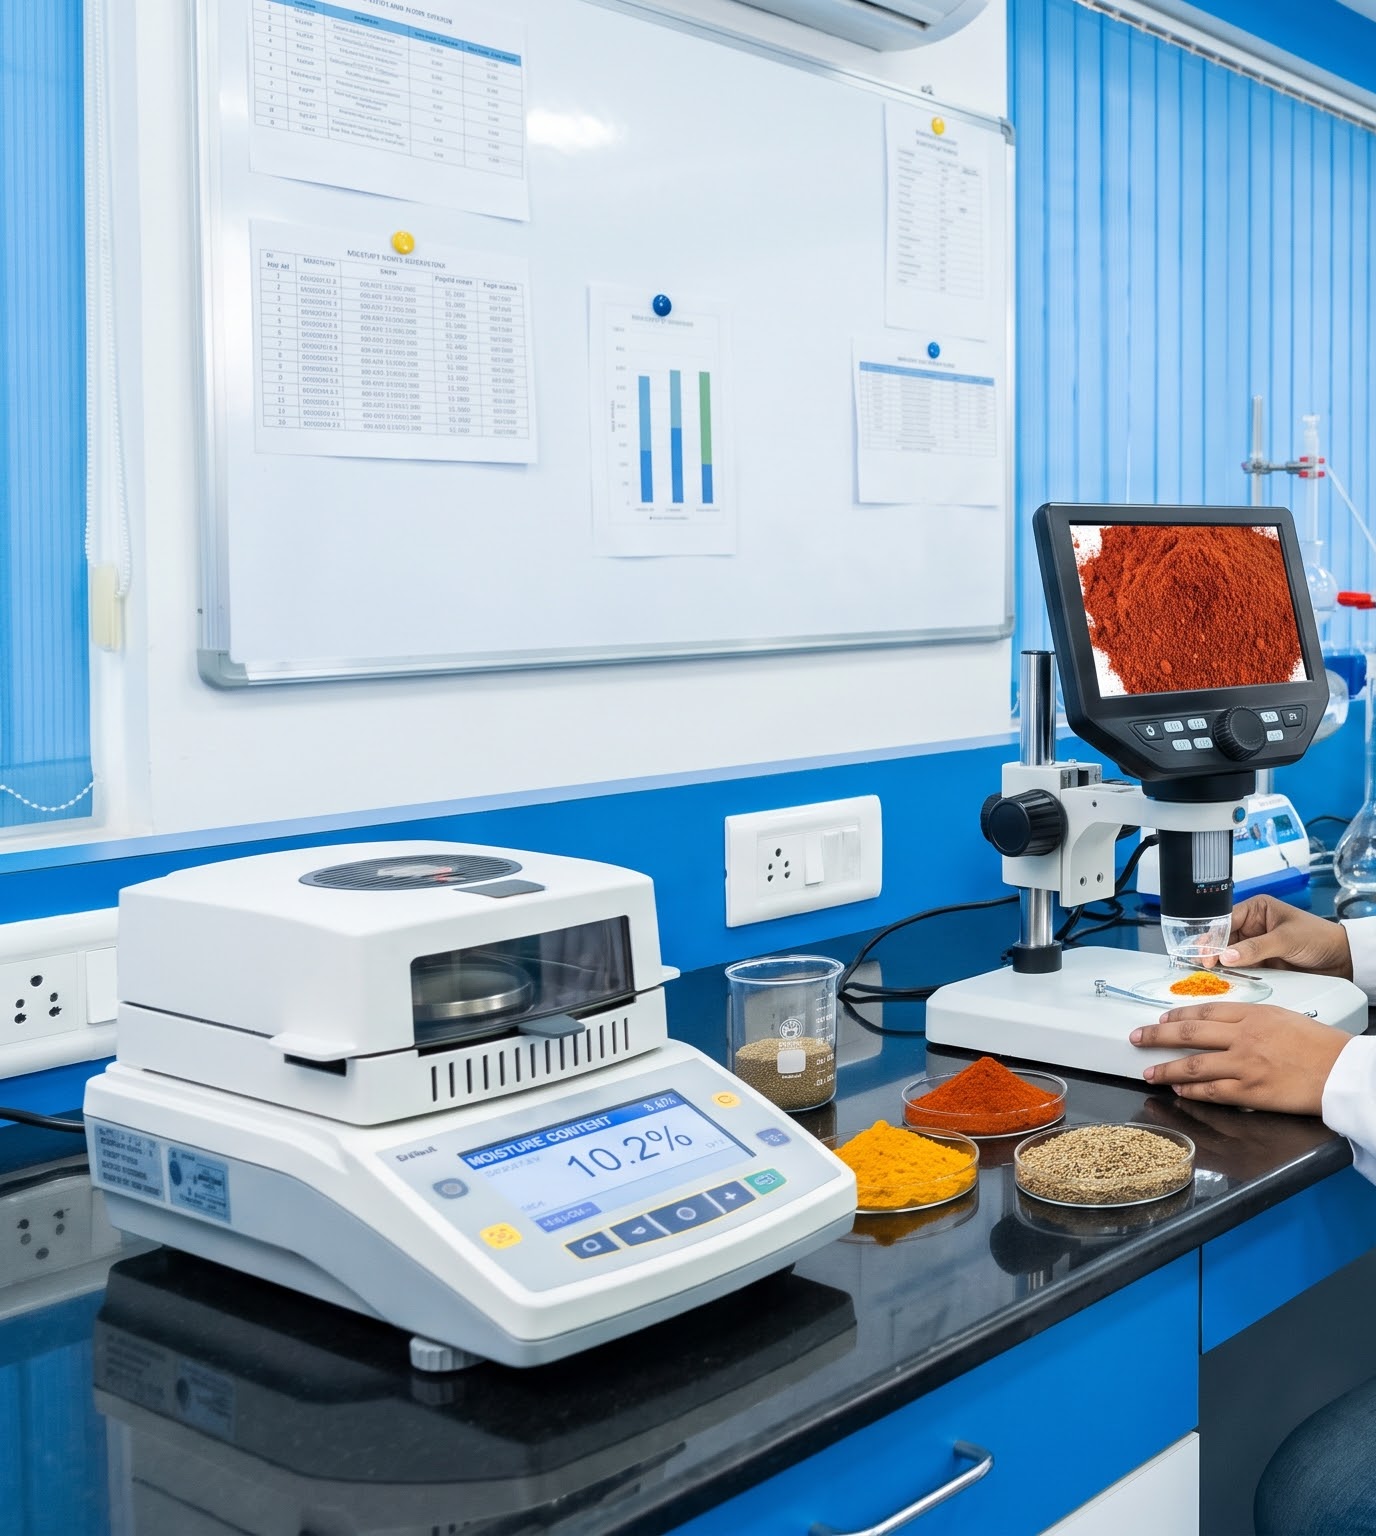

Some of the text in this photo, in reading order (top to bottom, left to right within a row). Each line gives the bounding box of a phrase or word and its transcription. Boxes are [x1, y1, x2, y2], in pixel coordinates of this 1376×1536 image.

[466, 1136, 546, 1168] MOISTURE
[546, 1115, 612, 1143] CONTENT
[566, 1125, 693, 1178] 10.2%
